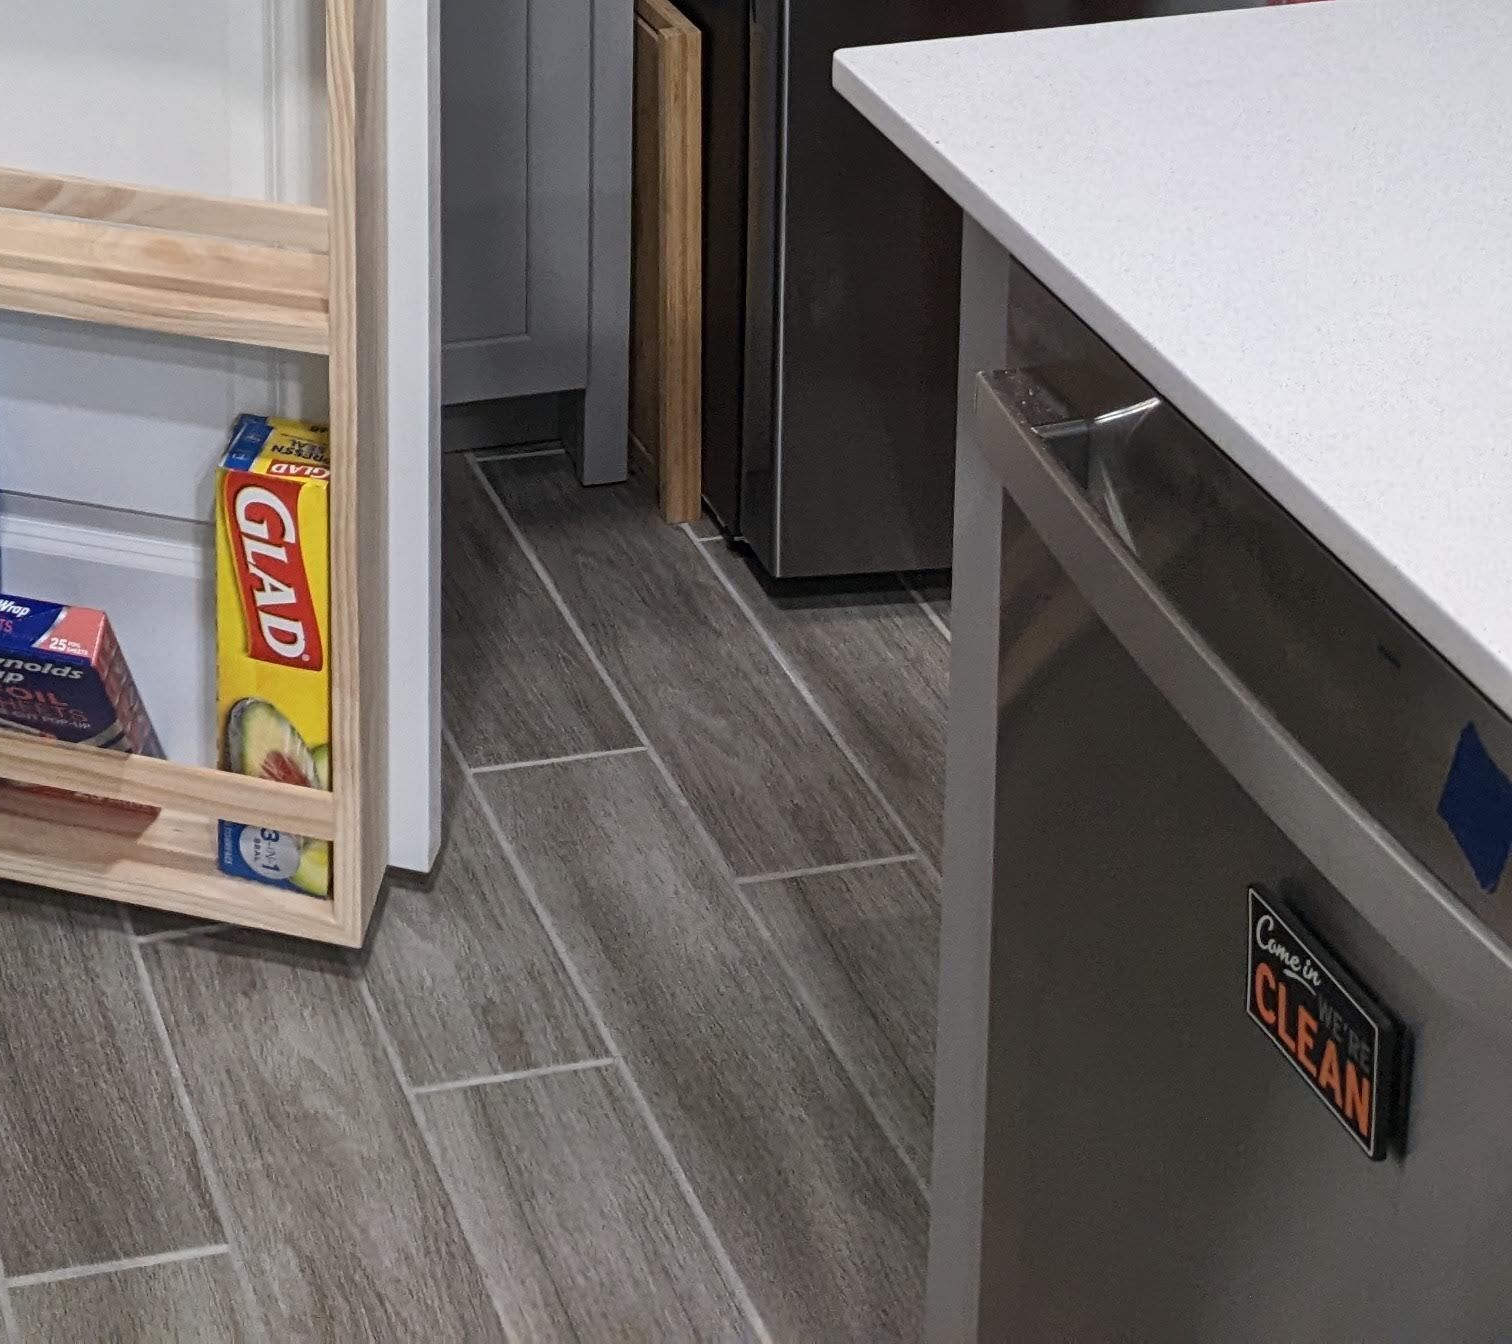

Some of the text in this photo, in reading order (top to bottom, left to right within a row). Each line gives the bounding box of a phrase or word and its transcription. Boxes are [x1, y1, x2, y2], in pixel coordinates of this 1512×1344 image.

[271, 463, 330, 479] GLAD
[234, 485, 308, 659] GLAD
[48, 637, 68, 653] 25
[1255, 914, 1322, 987] Come in
[1255, 962, 1370, 1138] CLEAN
